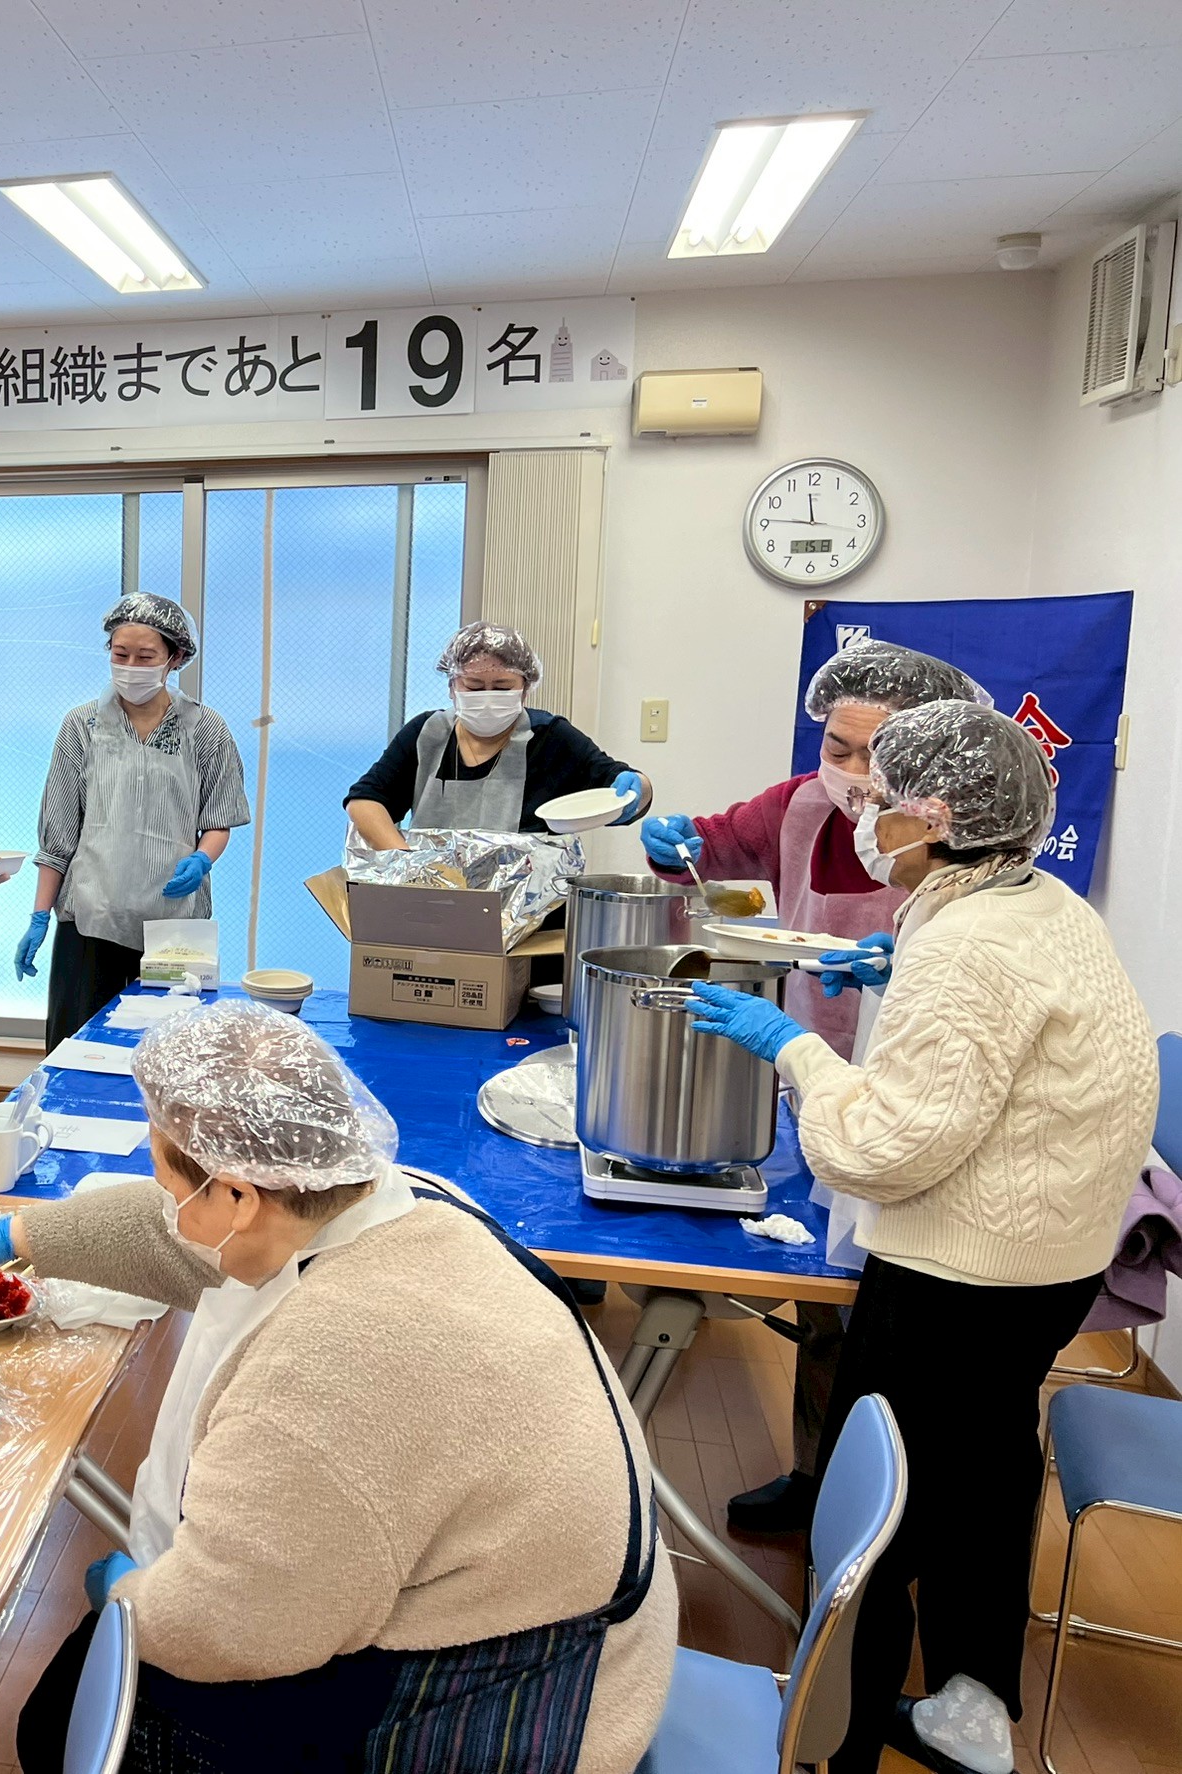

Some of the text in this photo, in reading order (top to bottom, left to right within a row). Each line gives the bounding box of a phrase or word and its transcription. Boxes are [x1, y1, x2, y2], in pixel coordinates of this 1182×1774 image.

[787, 479, 796, 492] 11
[808, 472, 821, 486] 12
[768, 496, 782, 509] 10
[849, 492, 859, 505] 2
[760, 518, 769, 531] 9
[857, 514, 866, 528] 3
[766, 540, 775, 552] 8
[847, 537, 857, 549] 4
[783, 556, 792, 568] 7
[805, 561, 815, 573] 6
[830, 555, 839, 568] 5
